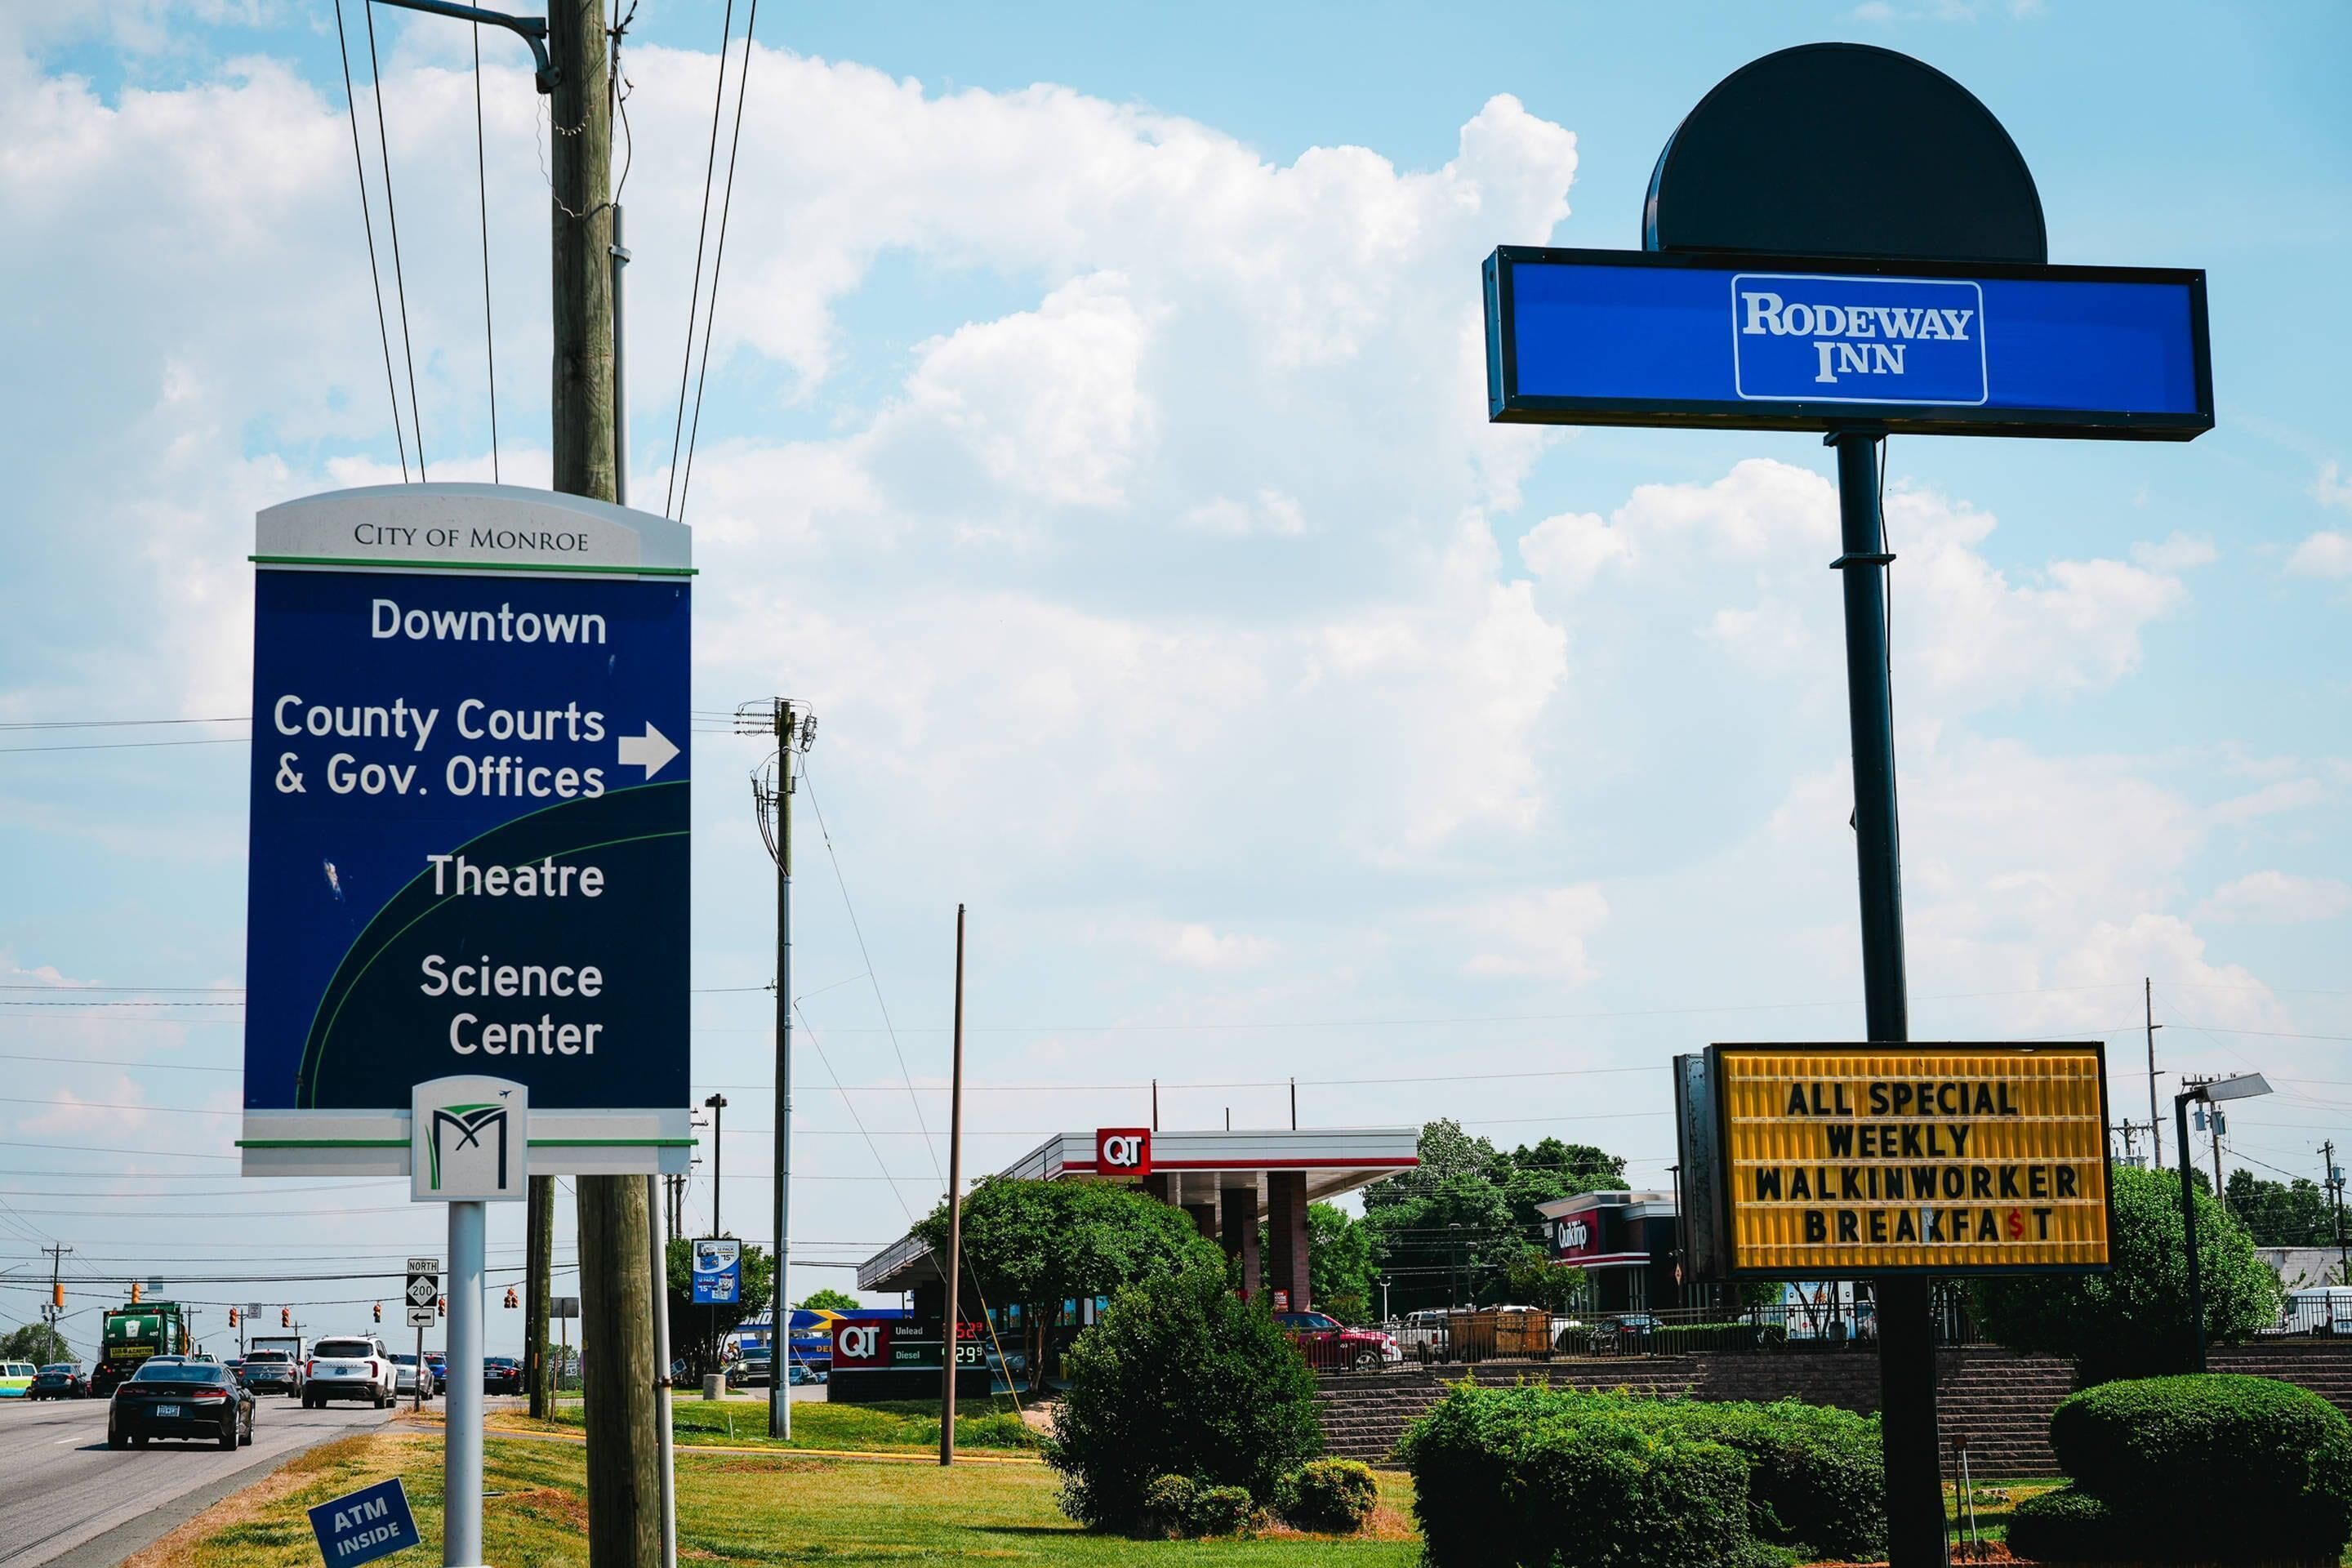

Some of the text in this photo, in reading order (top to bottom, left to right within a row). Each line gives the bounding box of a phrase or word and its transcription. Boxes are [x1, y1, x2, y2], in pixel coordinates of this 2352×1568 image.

[1813, 341, 1906, 383] INN
[470, 528, 589, 551] MONROE
[372, 599, 607, 644] Downtown
[274, 694, 605, 751] County Courts
[274, 752, 605, 798] & Gov. Offices
[426, 854, 605, 898] Theatre
[420, 955, 603, 996] Science
[449, 1013, 604, 1055] Center
[1787, 1083, 2019, 1116] ALL SPECIAL
[1103, 1136, 1142, 1166] QT
[1827, 1125, 1970, 1157] WEEKLY
[1756, 1165, 2078, 1200] WALKINWORKER
[1558, 1220, 1587, 1250] QuikTrip
[409, 1262, 437, 1271] NORTH
[412, 1285, 433, 1296] 200
[839, 1325, 880, 1359] QT
[895, 1326, 924, 1335] Unlead
[896, 1350, 920, 1360] Diesel
[335, 1497, 389, 1533] ATM
[336, 1521, 400, 1557] INSIDE
